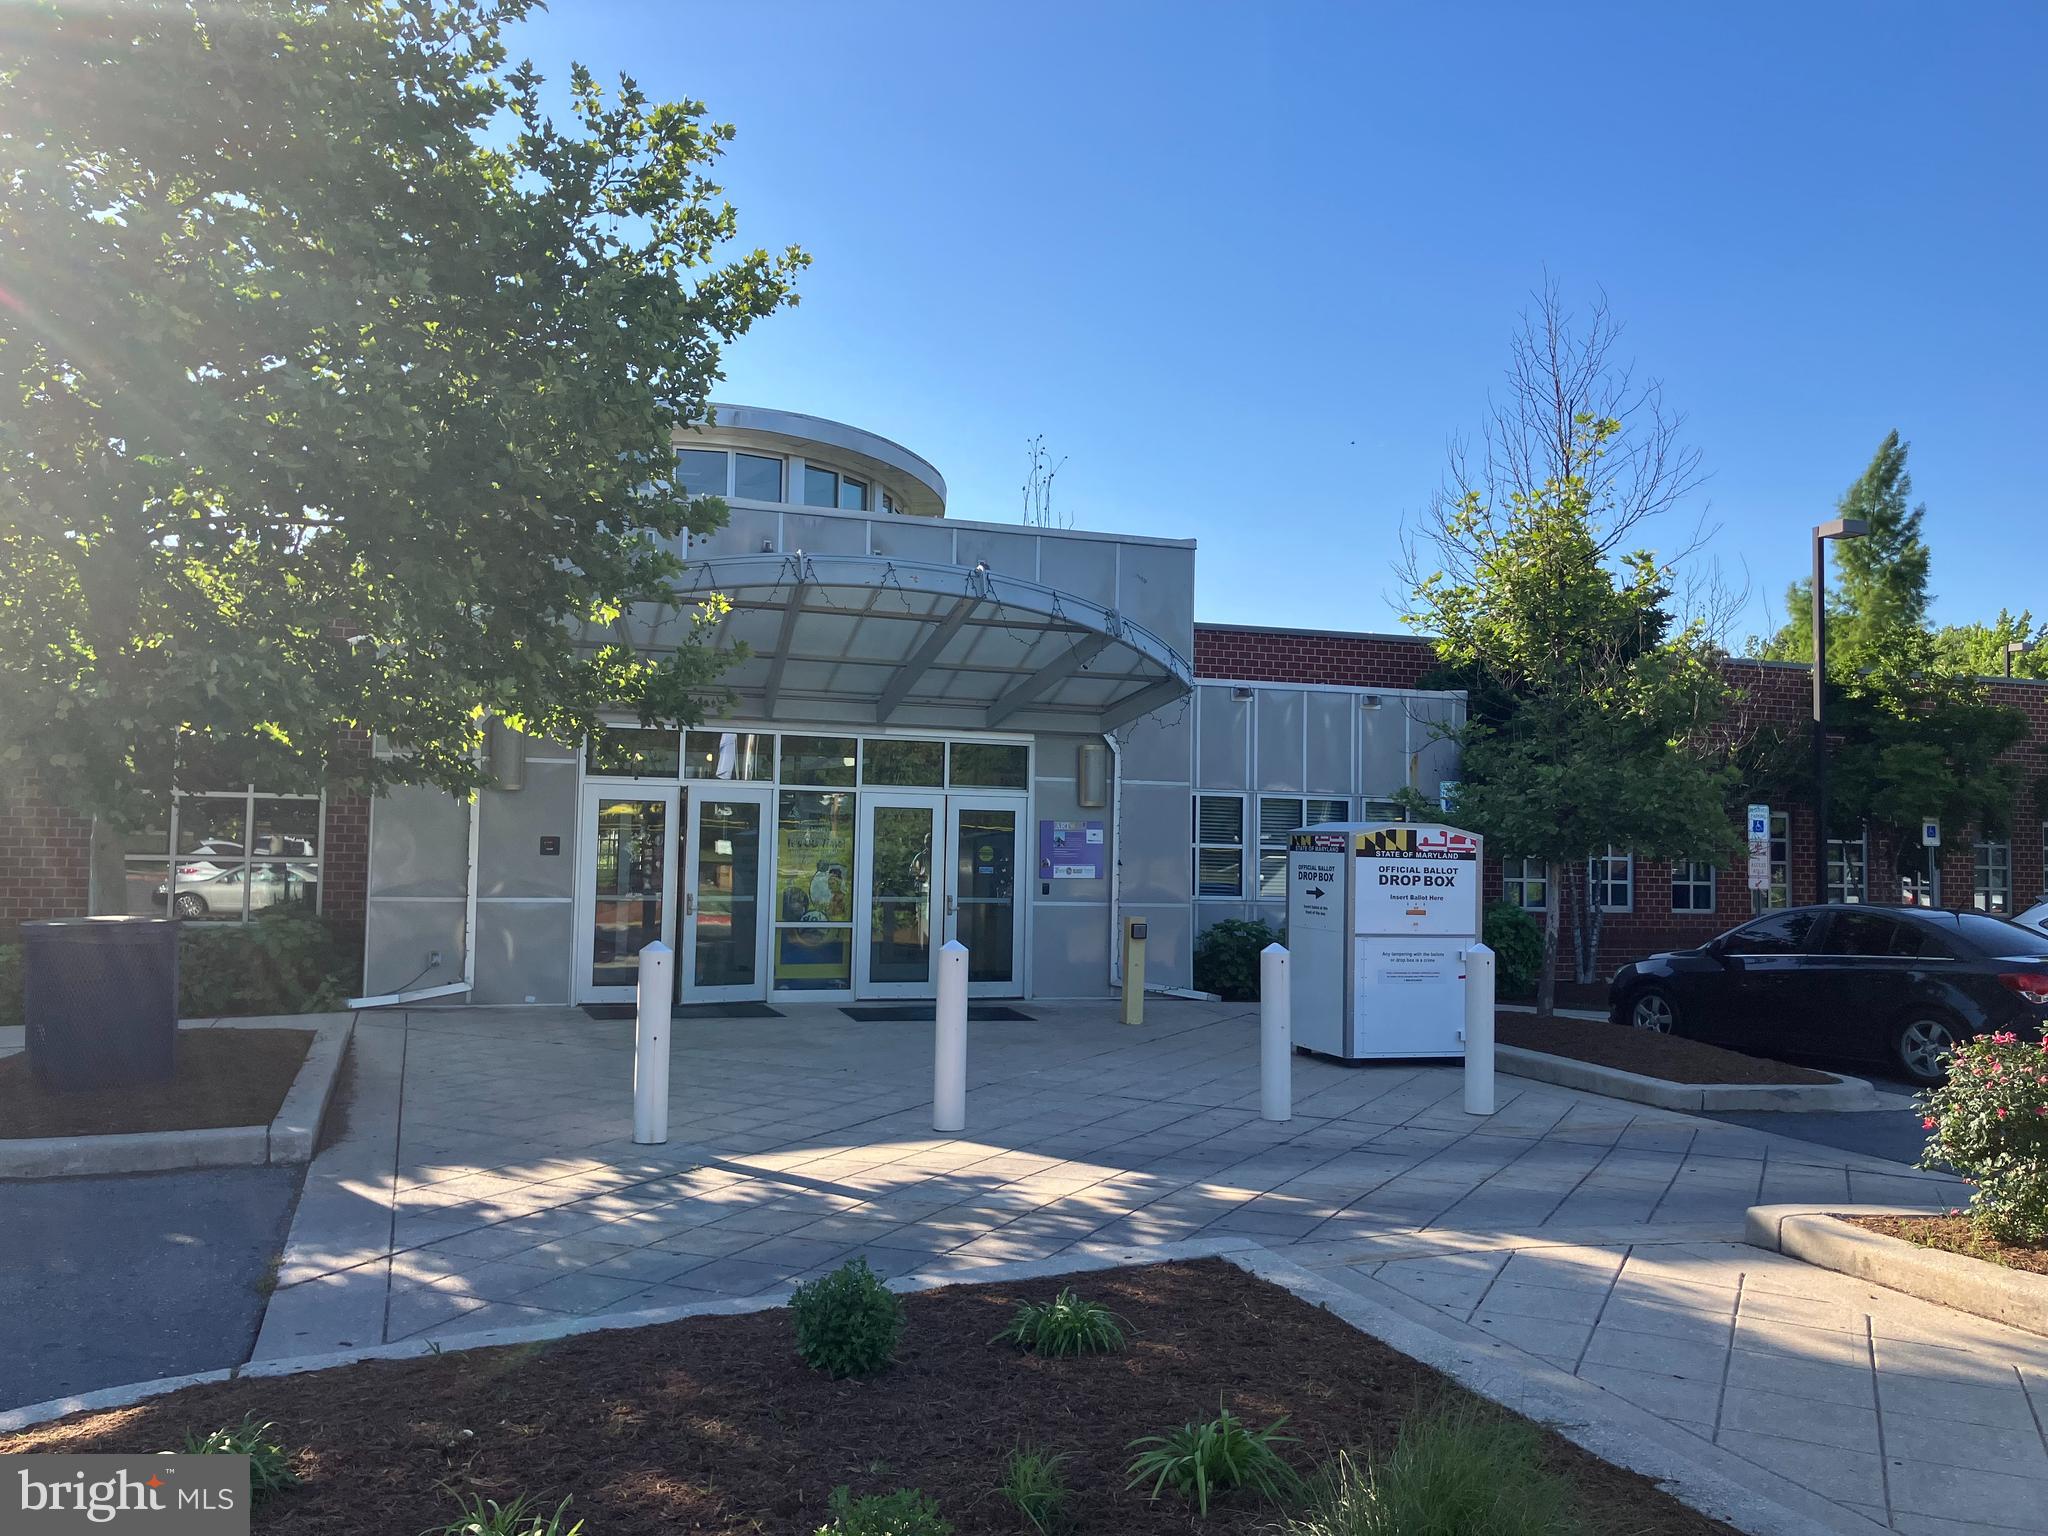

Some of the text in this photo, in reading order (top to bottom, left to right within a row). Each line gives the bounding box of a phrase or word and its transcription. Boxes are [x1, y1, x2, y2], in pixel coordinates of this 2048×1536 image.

[1375, 850, 1400, 858] STATE
[1415, 852, 1459, 860] MARYLAND
[1378, 865, 1459, 875] OFFICIAL BALLOT
[1298, 871, 1334, 882] DROP BOX
[1378, 874, 1455, 887] DROP BOX
